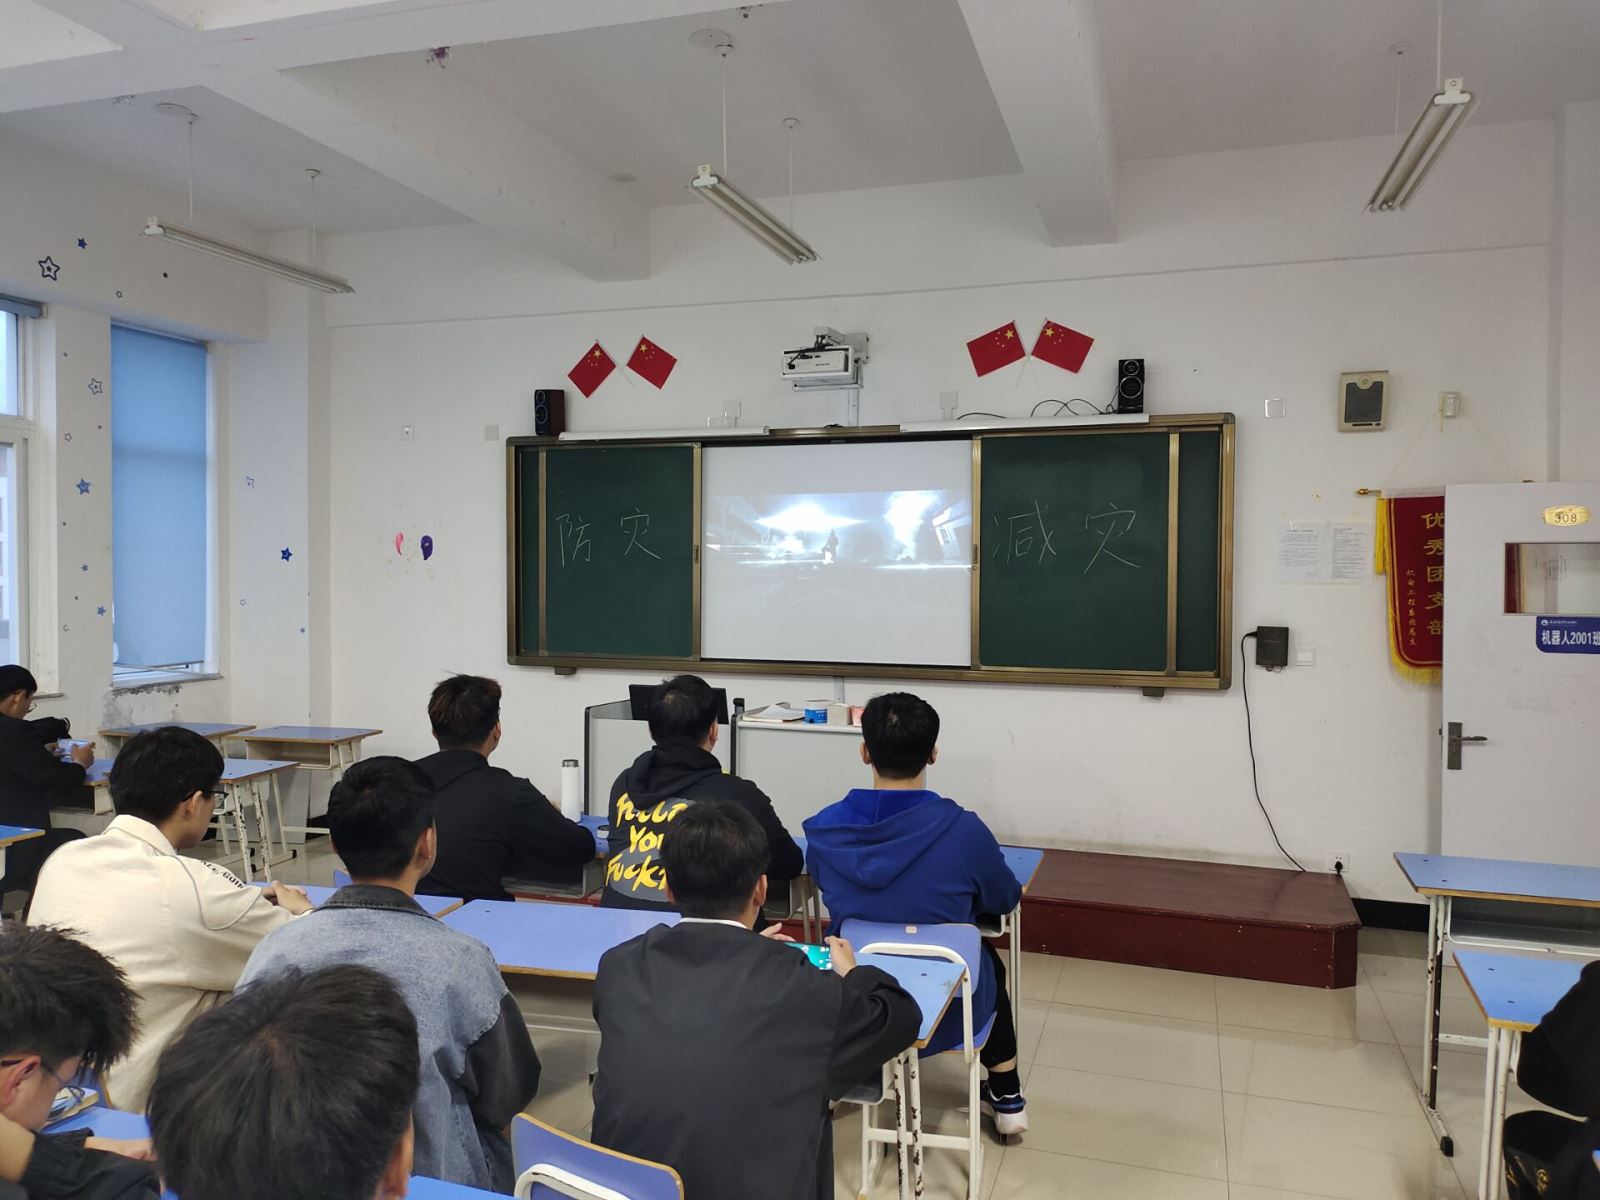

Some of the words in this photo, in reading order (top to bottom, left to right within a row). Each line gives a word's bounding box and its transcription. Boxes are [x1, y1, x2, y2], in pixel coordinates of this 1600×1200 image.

[555, 506, 662, 568] 防灾
[1541, 629, 1600, 646] 机器人2001班
